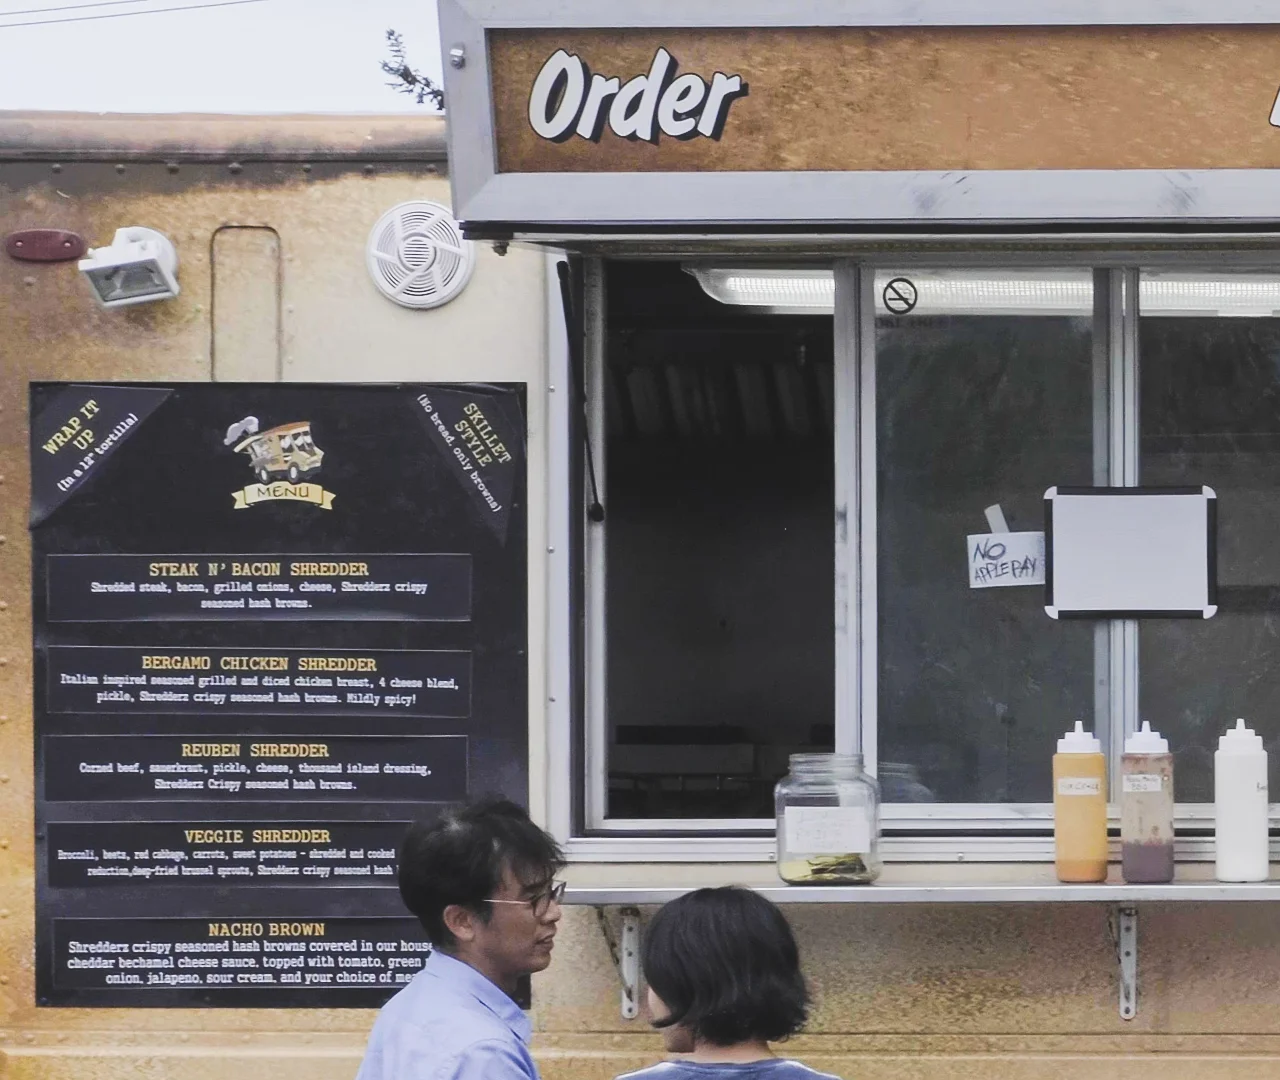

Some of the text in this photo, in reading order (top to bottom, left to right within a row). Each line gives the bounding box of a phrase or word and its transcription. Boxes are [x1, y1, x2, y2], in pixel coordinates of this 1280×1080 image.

[528, 46, 744, 141] Order
[42, 399, 100, 455] WRAP IT
[463, 402, 512, 463] SKILLET
[73, 429, 95, 450] UP
[454, 420, 493, 467] STYLE
[56, 475, 75, 492] (In
[73, 468, 83, 477] a
[94, 412, 139, 454] tortilla)
[417, 393, 432, 412] (No
[453, 447, 473, 470] only
[470, 471, 502, 512] browns)
[257, 484, 310, 499] MENU
[973, 538, 1006, 563] NO
[149, 563, 199, 576] STEAK
[231, 563, 281, 576] BACON
[290, 563, 369, 576] SHREDDER
[91, 582, 135, 592] Shredded
[214, 582, 252, 594] grilled
[395, 582, 428, 594] crispy
[142, 656, 377, 671] BERGAMO CHICKEN SHREDDER
[60, 673, 98, 684] Italian
[103, 675, 146, 687] inspired
[151, 675, 194, 686] seasoned
[198, 676, 237, 688] grilled
[241, 676, 258, 686] and
[262, 676, 290, 686] diced
[294, 676, 332, 687] chicken
[379, 677, 386, 687] 4
[390, 678, 422, 688] cheese
[139, 691, 189, 702] Shredderz
[193, 692, 226, 704] crispy
[230, 693, 274, 703] seasoned
[278, 692, 301, 703] hash
[346, 693, 380, 706] Mildly
[384, 694, 416, 706] spicy!
[182, 744, 329, 757] REUBEN SHREDDER
[213, 763, 251, 775] pickle,
[299, 763, 342, 773] thousand
[347, 763, 379, 773] island
[383, 763, 431, 776] dressing,
[154, 779, 204, 789] Shredderz
[208, 779, 241, 791] Crispy
[245, 779, 289, 789] seasoned
[184, 830, 331, 843] VEGGIE SHREDDER
[367, 849, 395, 859] cooked
[303, 866, 330, 877] crispy
[208, 923, 325, 937] NACHO BROWN
[68, 941, 129, 953] Shredderz
[132, 941, 171, 954] crispy
[175, 940, 229, 952] seasoned
[233, 940, 260, 952] hash
[263, 940, 306, 952] browns
[309, 940, 357, 952] covered
[361, 940, 373, 952] in
[376, 942, 397, 952] our
[67, 957, 115, 969] cheddar
[119, 957, 174, 969] bechamel
[178, 957, 218, 968] cheese
[263, 956, 304, 970] topped
[307, 956, 334, 968] with
[388, 958, 421, 969] green
[206, 974, 234, 984] sour
[280, 972, 301, 983] and
[305, 974, 333, 985] your
[336, 972, 376, 983] choice
[379, 971, 392, 983] of
